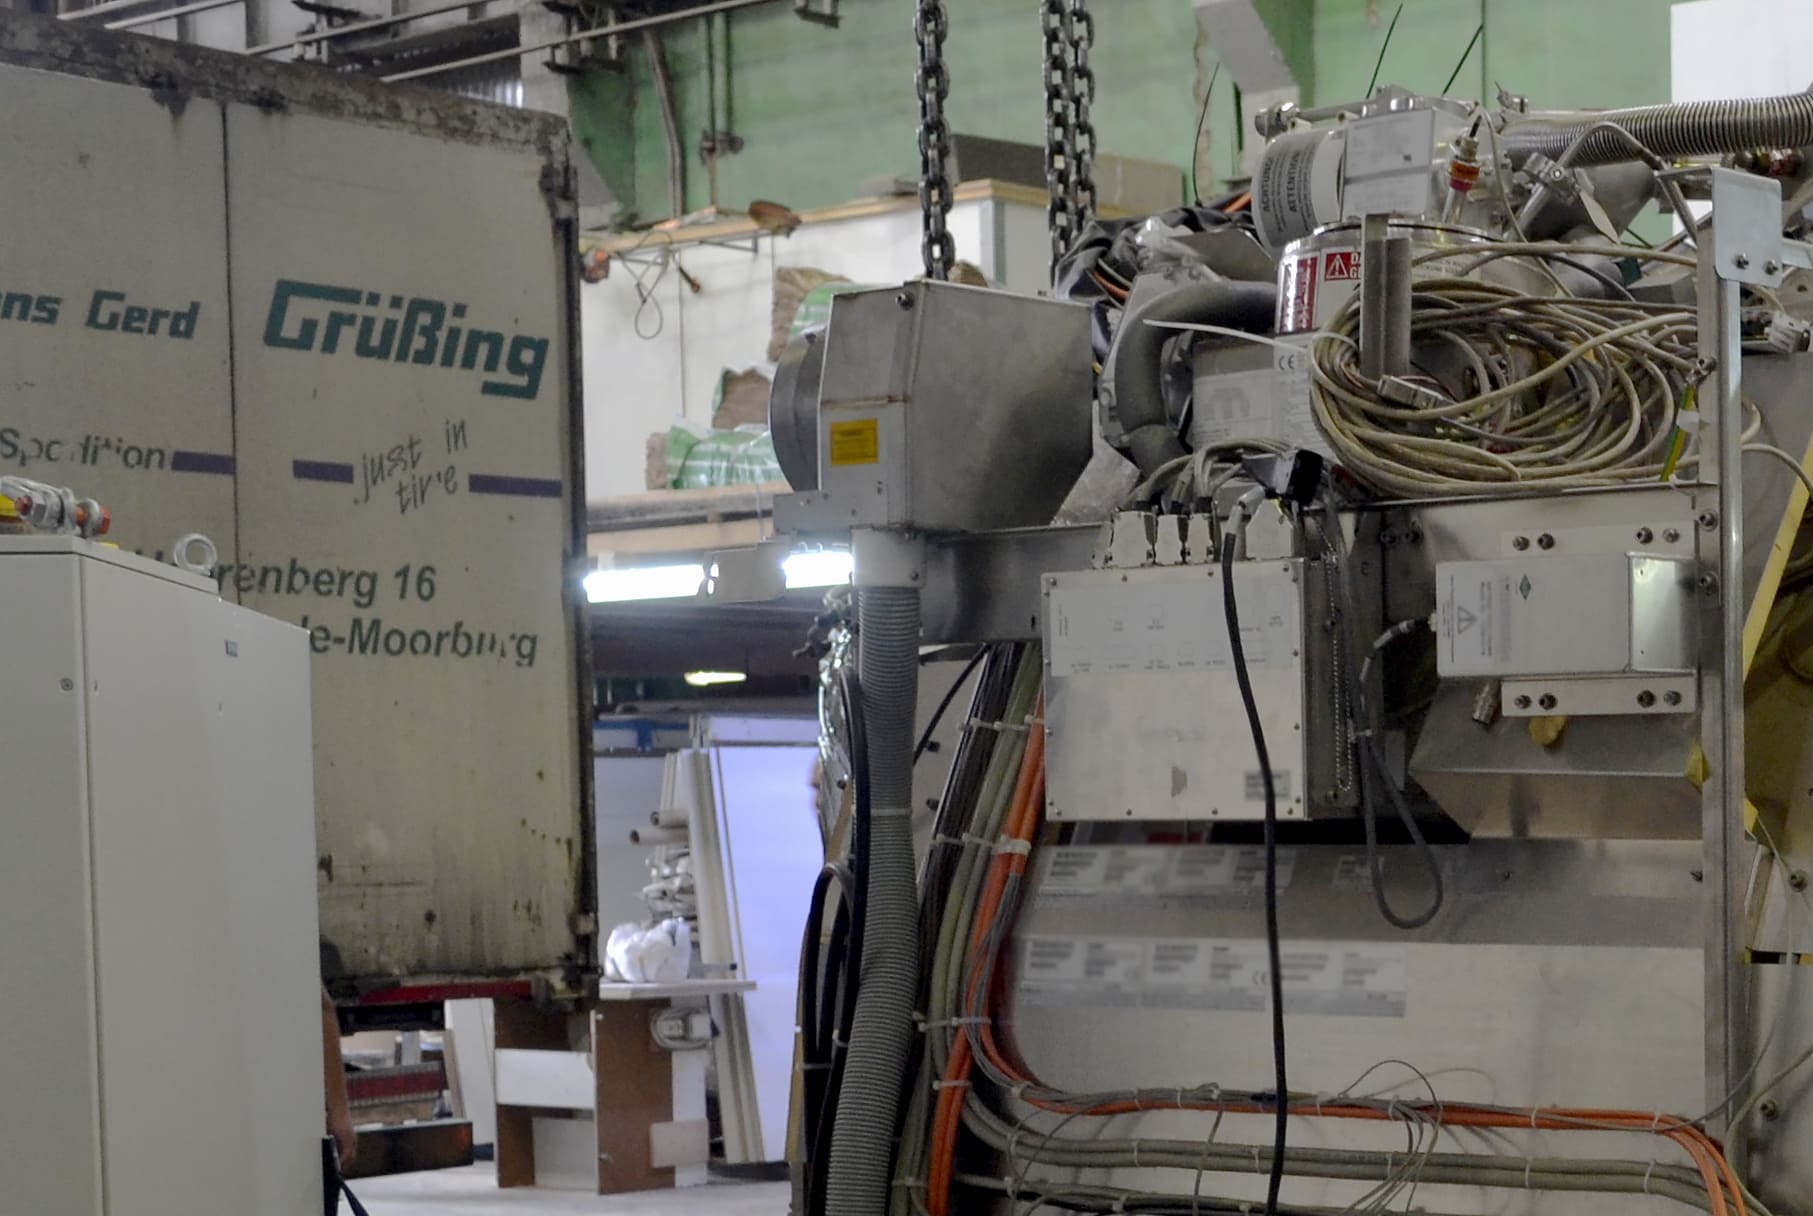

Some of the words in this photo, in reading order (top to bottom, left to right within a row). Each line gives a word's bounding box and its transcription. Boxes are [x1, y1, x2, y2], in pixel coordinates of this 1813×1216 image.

[0, 291, 63, 326] ns
[85, 289, 201, 340] Gerd
[445, 418, 468, 455] in
[208, 557, 378, 609] renberg
[394, 564, 437, 602] 16
